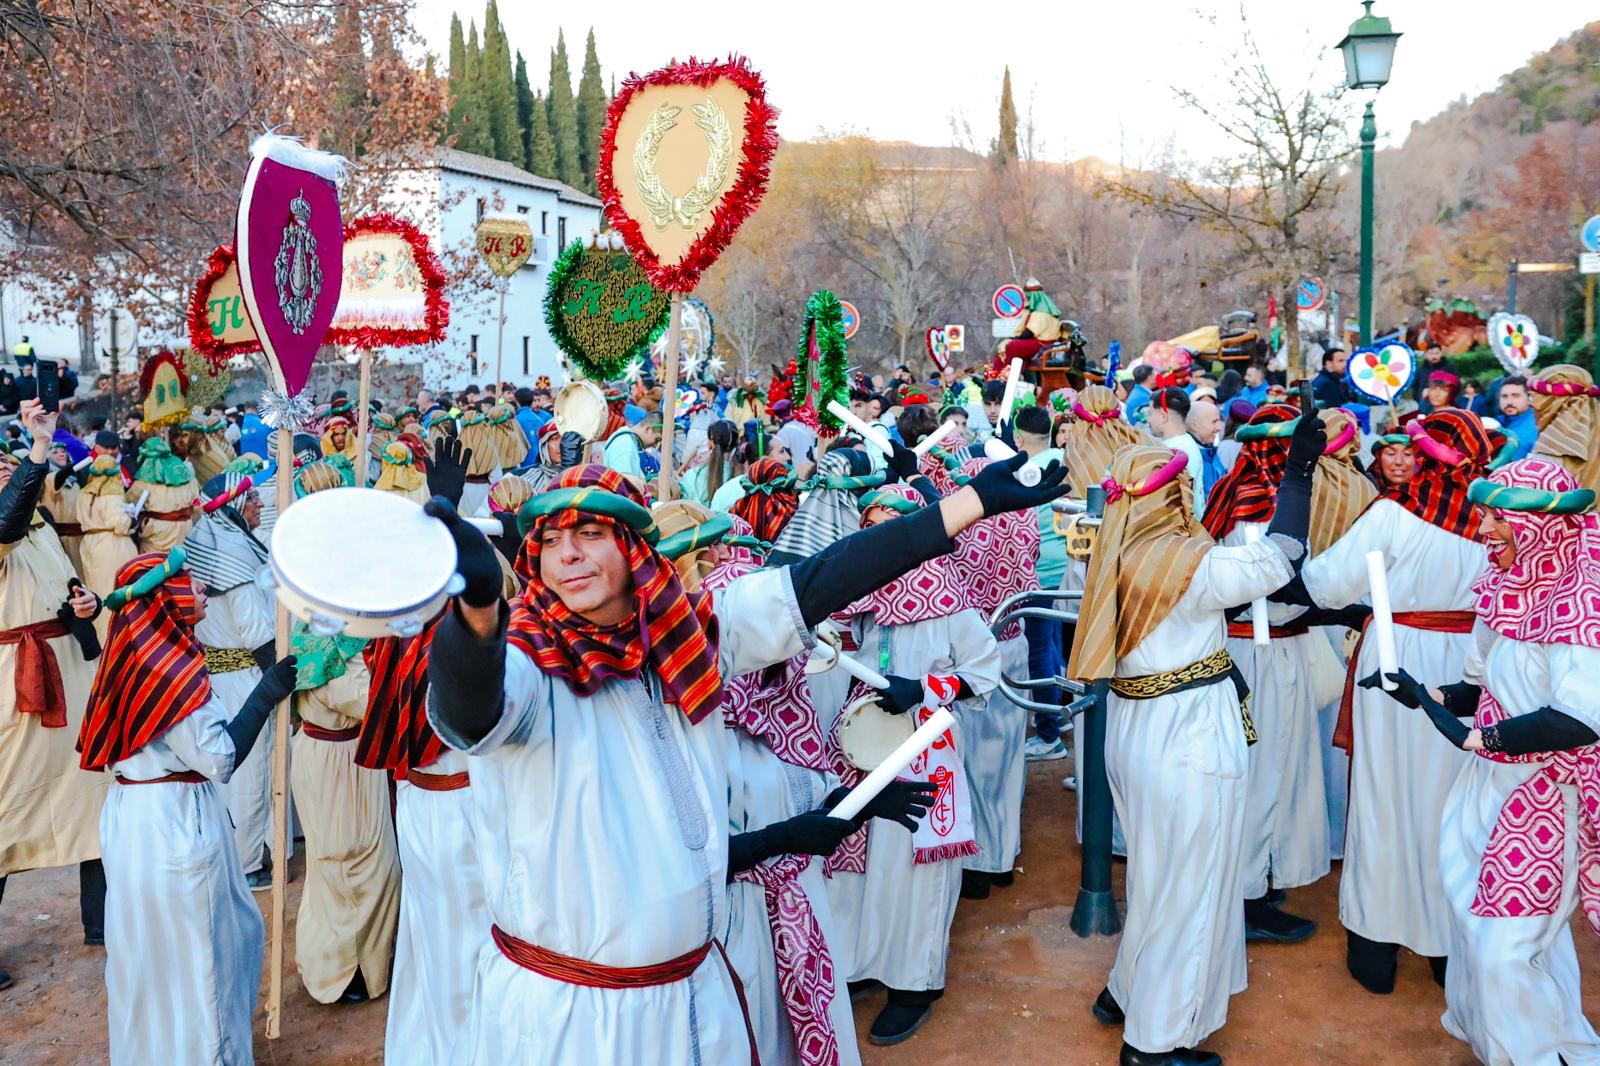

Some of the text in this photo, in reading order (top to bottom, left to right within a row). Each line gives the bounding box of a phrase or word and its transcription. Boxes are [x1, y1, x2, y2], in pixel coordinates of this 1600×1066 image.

[484, 235, 527, 257] H R
[208, 295, 244, 336] H
[565, 278, 653, 324] H R
